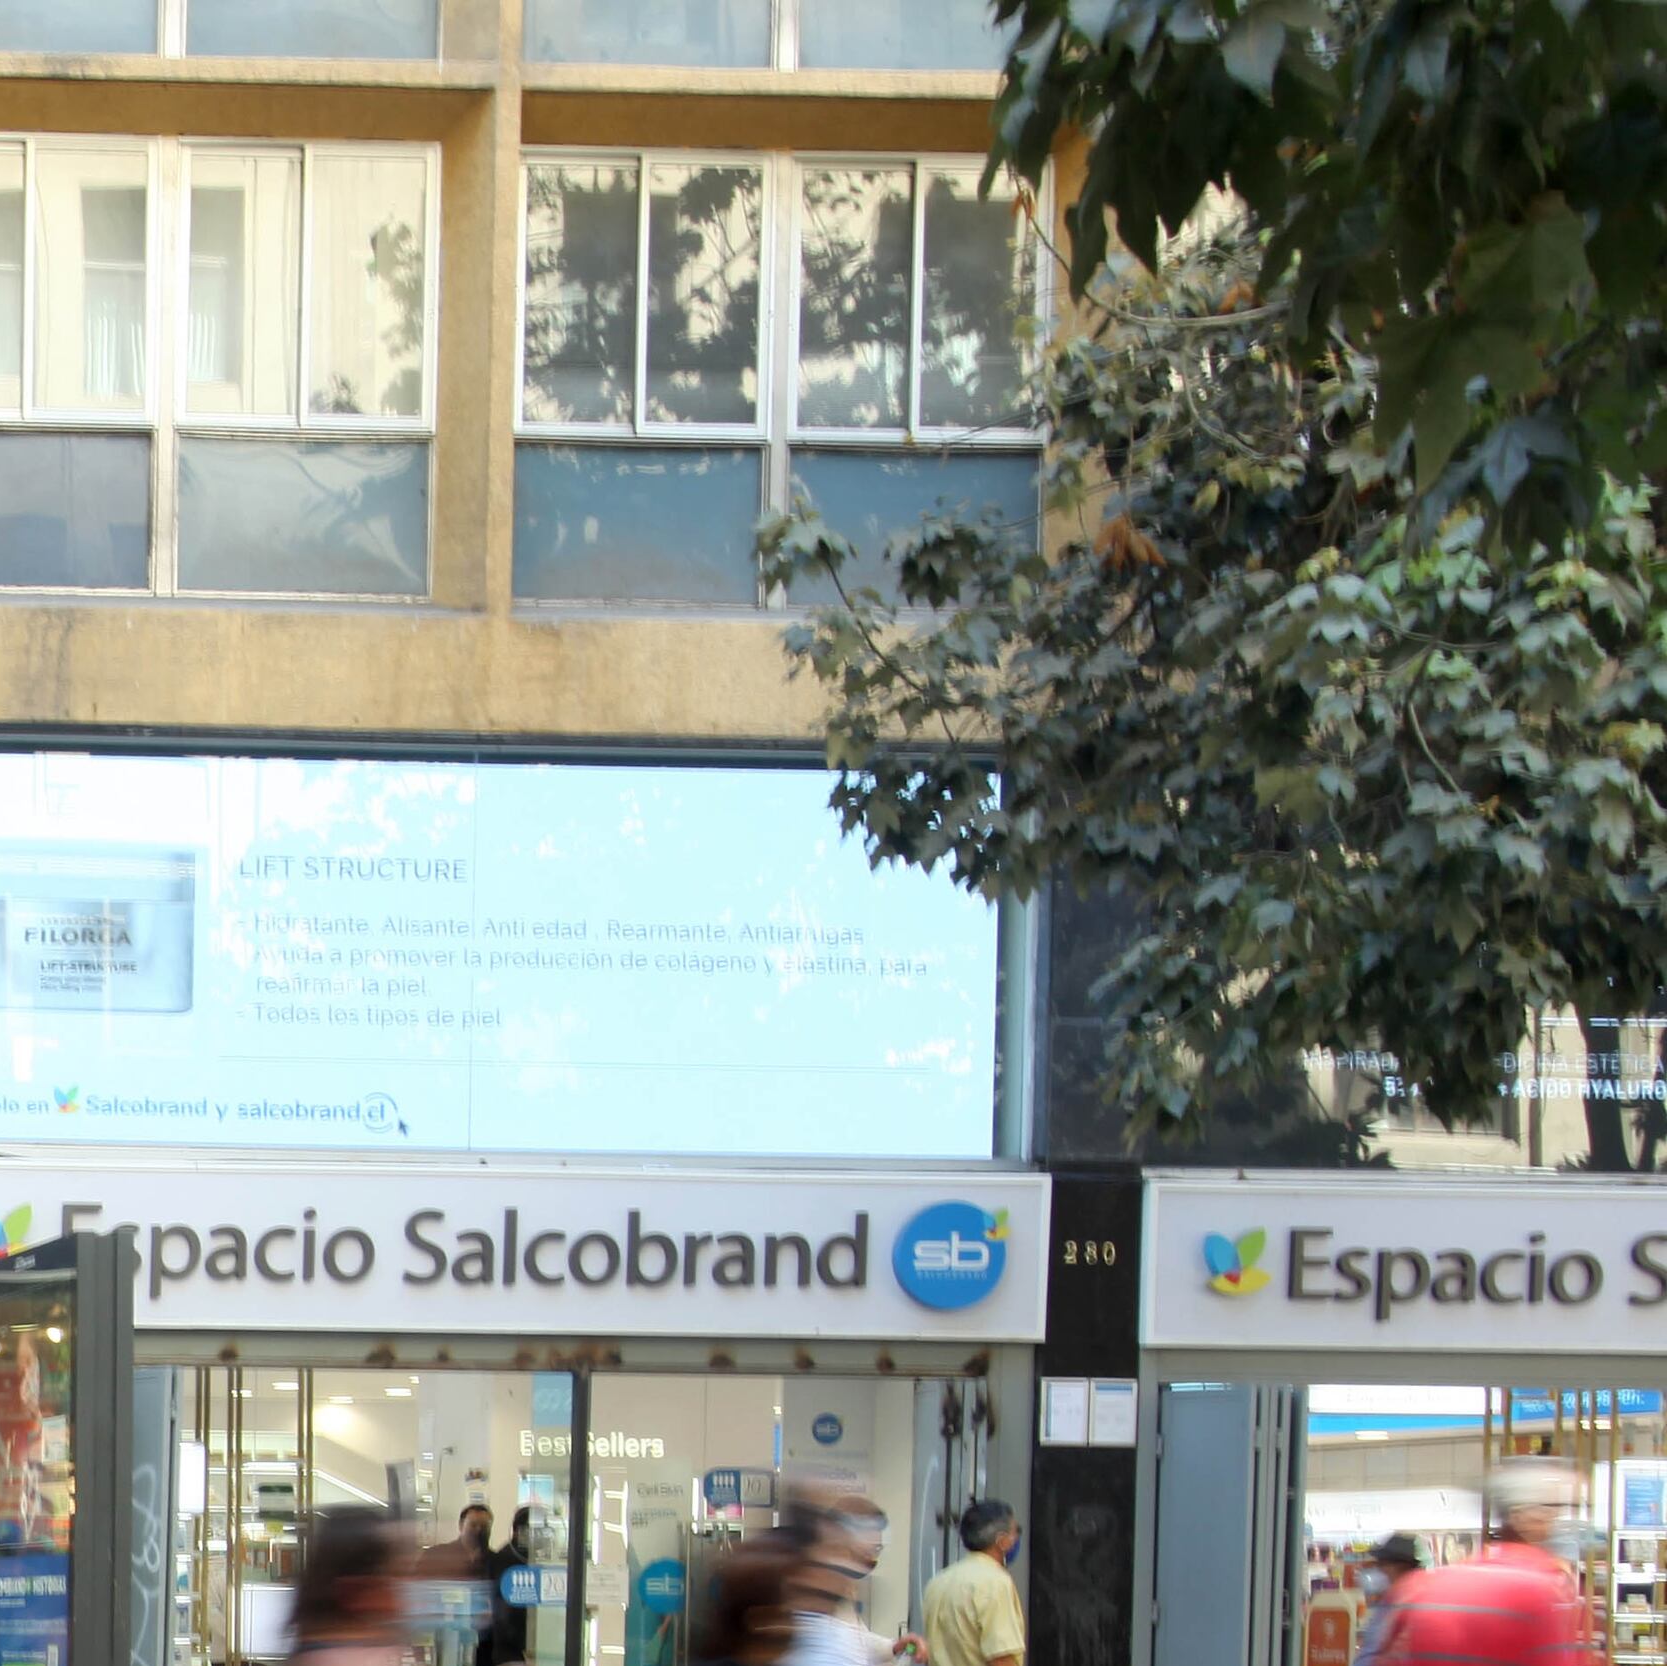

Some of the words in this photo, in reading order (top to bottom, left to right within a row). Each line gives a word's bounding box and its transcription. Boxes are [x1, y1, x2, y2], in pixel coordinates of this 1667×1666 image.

[239, 855, 295, 880] LIFT
[301, 856, 468, 882] STRUCTURE
[532, 916, 589, 940] edad
[619, 949, 648, 970] de
[426, 1005, 455, 1027] de
[26, 1100, 50, 1115] en
[85, 1096, 208, 1119] Salcobrand
[402, 1207, 869, 1289] Salcobrand
[913, 1230, 990, 1272] sb
[1063, 1240, 1117, 1266] 280
[1287, 1226, 1604, 1323] Espacio
